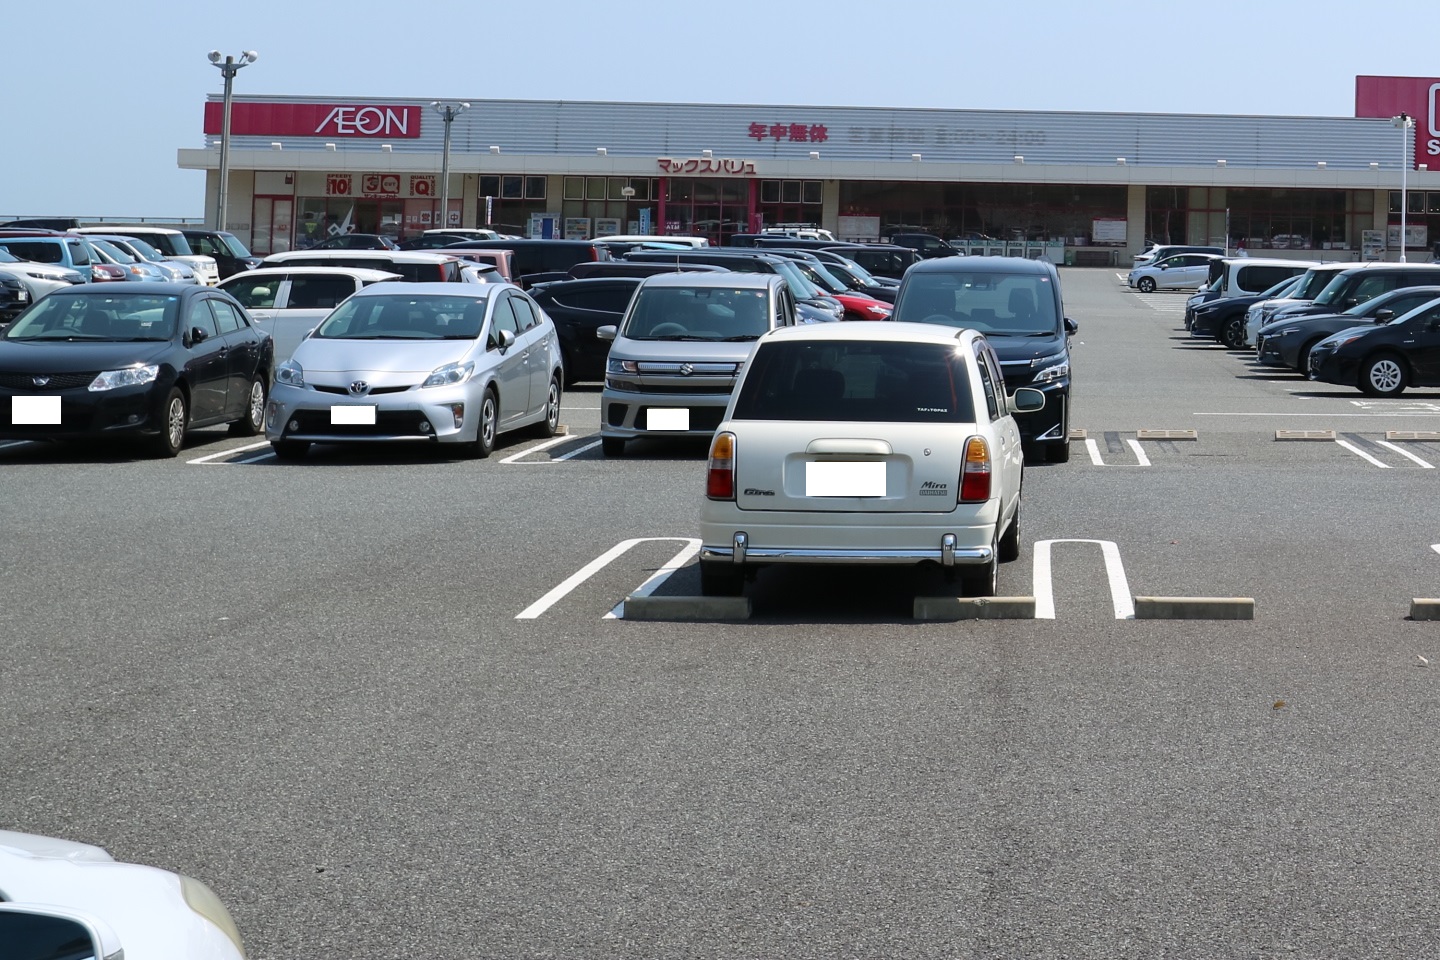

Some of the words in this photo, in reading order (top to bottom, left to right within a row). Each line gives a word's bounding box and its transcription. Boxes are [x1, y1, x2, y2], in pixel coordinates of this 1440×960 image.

[749, 122, 828, 142] 年中無休
[658, 159, 756, 174] マックスバリュ
[331, 179, 348, 194] 10
[416, 180, 430, 196] Q
[921, 481, 947, 489] Mira
